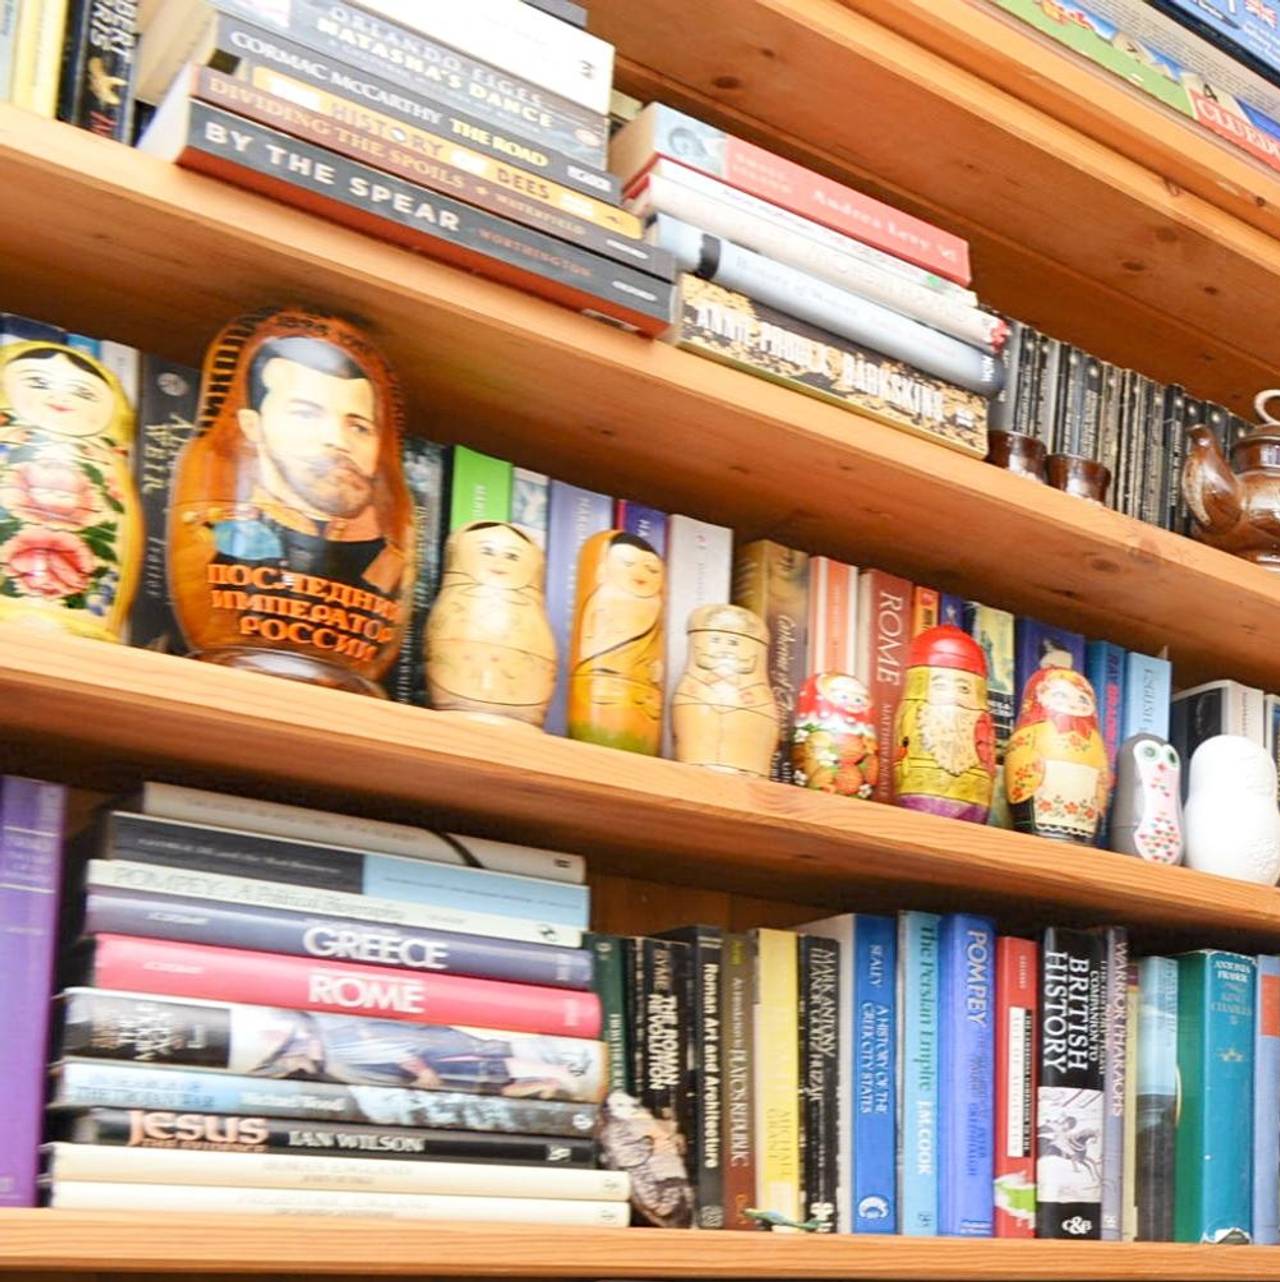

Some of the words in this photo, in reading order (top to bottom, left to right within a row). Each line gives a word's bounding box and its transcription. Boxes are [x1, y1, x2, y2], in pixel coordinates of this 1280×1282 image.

[113, 0, 138, 63] BERT
[328, 5, 463, 72] ORLANDO
[229, 29, 328, 82] CORMAC
[449, 118, 490, 146] THE
[490, 133, 550, 168] ROAD
[316, 17, 462, 89] NATASHA'S
[467, 80, 555, 130] DANCE
[209, 76, 332, 136] DIVIDING
[336, 128, 385, 158] THE
[388, 145, 465, 190] SPOILS
[330, 101, 444, 157] HISTORY
[204, 122, 253, 152] BY
[265, 143, 335, 186] THE
[349, 177, 461, 233] SPEAR
[240, 614, 380, 662] РОССИИ
[876, 591, 903, 687] ROME
[302, 925, 448, 970] GREECE
[821, 949, 837, 991] MARK
[919, 925, 934, 957] The
[308, 971, 426, 1015] ROME
[661, 995, 678, 1025] THE
[703, 963, 720, 1012] Roman
[919, 959, 935, 1024] Persian
[965, 930, 988, 1028] POMPEY
[1113, 942, 1129, 1021] WARRIOR
[646, 993, 664, 1091] REVOLUTION
[703, 1016, 720, 1038] Art
[821, 993, 838, 1058] ANTONY
[874, 1020, 889, 1068] HISTORY
[1044, 951, 1069, 1074] HISTORY
[1068, 957, 1090, 1071] BRITISH
[661, 1028, 679, 1086] ROMAN
[703, 1042, 720, 1062] and
[913, 1026, 935, 1092] Empire
[1109, 1023, 1126, 1117] PHARAOHS
[288, 1130, 329, 1148] IAN
[331, 1132, 424, 1155] WILSON
[703, 1065, 720, 1168] Architecture
